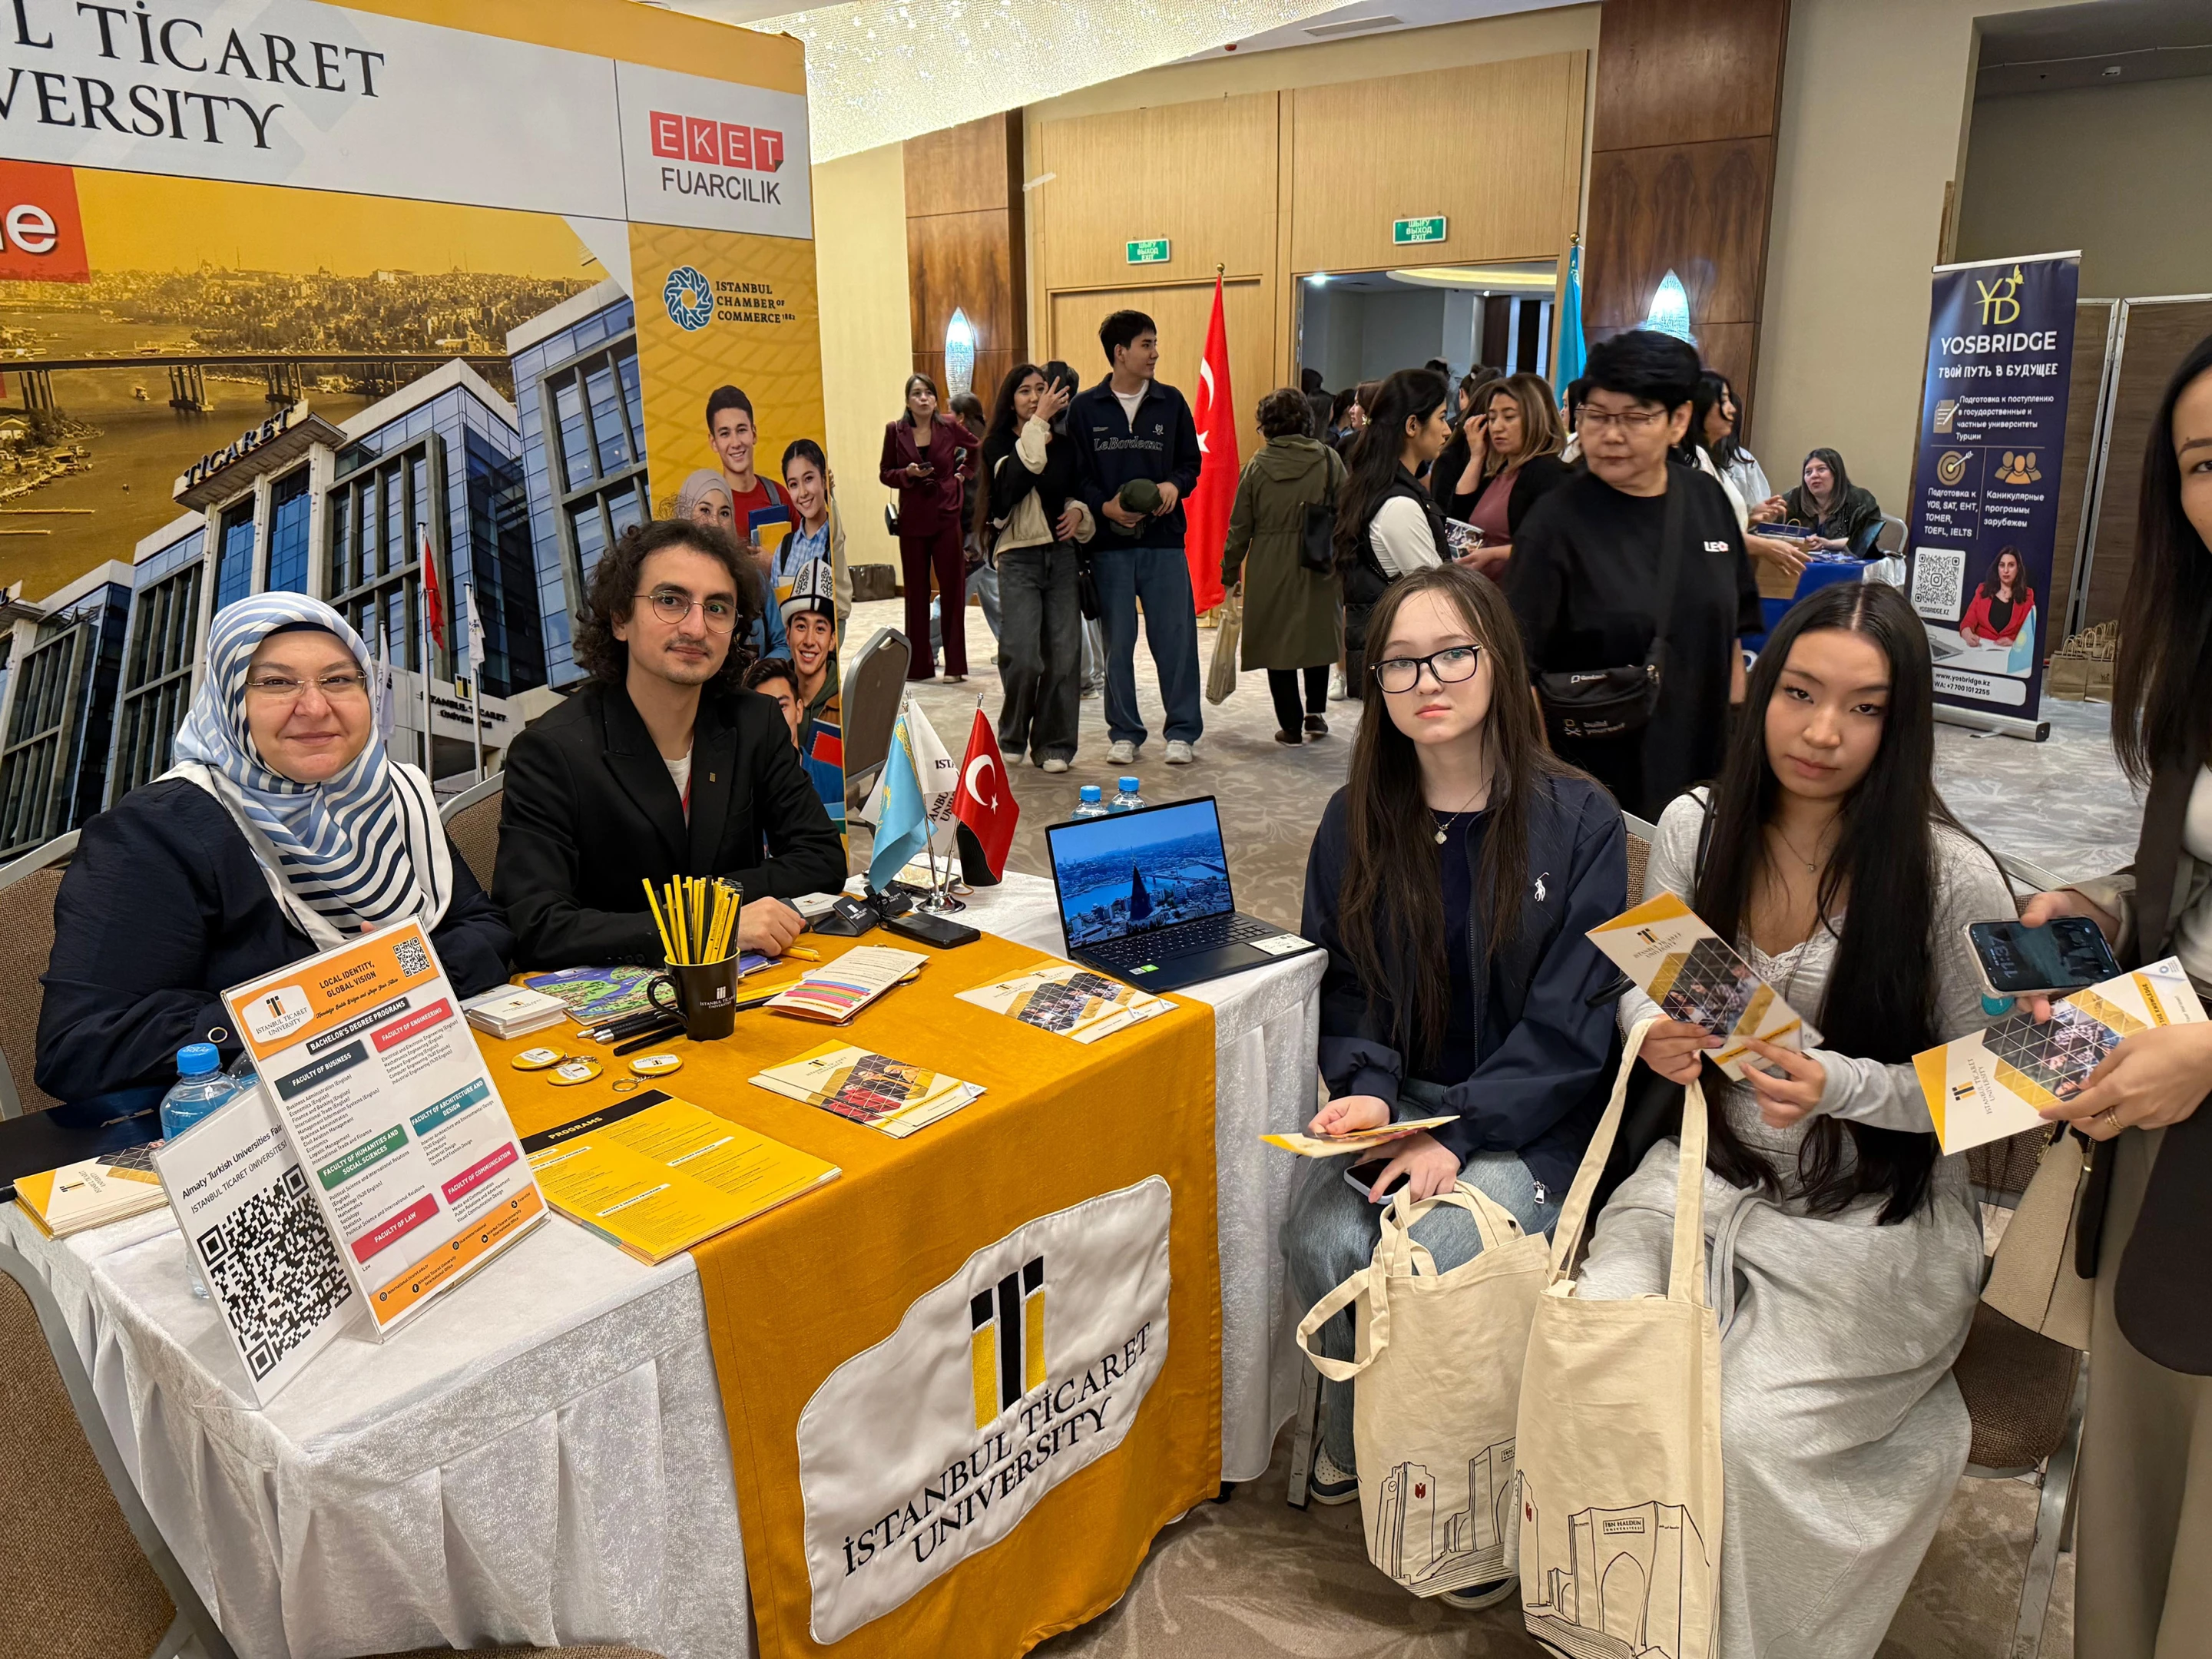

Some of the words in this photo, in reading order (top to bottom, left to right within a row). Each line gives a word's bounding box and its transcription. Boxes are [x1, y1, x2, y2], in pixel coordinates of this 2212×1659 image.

[78, 0, 385, 98] TİCARET
[659, 118, 778, 166] EKET
[661, 167, 782, 205] FUARCILIK
[0, 204, 56, 253] e
[1406, 226, 1432, 234] ВЫХОД
[715, 280, 773, 294] ISTANBUL
[716, 296, 775, 309] CHAMBER
[717, 310, 781, 323] COMMERCE
[1940, 331, 2057, 355] YOSBRIDGE
[1939, 365, 1962, 378] ТВОЙ
[1964, 365, 1992, 378] ПУТЬ
[1995, 365, 2003, 377] В
[2006, 363, 2058, 378] БУДУЩЕЕ
[1959, 396, 2000, 406] Подготовка
[2008, 395, 2054, 404] поступлению
[1963, 408, 2026, 417] государственные
[1955, 432, 1982, 441] Турции
[1957, 420, 1986, 429] частные
[1988, 420, 2038, 429] университеты
[1928, 488, 1969, 498] Подготовка
[1987, 490, 2045, 502] Каникулярные
[1926, 513, 1952, 524] TOMER,
[1927, 501, 1941, 511] YOS,
[1943, 502, 1958, 512] SAT,
[1985, 505, 2030, 514] программы
[1924, 526, 1949, 537] TOEFL,
[1951, 528, 1972, 537] IELTS
[1936, 673, 1990, 686] www.yosbridge.kz
[319, 975, 342, 988] LOCAL
[342, 961, 374, 979] IDENTITY,
[326, 982, 354, 997] GLOBAL
[353, 971, 376, 985] VISION
[268, 1017, 300, 1035] UNIVERSITY
[310, 1027, 349, 1050] BACHELOR'S
[349, 1015, 373, 1031] DEGREE
[373, 1000, 405, 1019] PROGRAMS
[382, 1026, 402, 1041] FACULTY
[410, 1007, 442, 1026] ENGINEERING
[292, 1069, 316, 1086] FACULTY
[324, 1052, 351, 1069] BUSINESS
[286, 1099, 305, 1111] Business
[306, 1084, 334, 1101] Administration
[411, 1109, 432, 1124] FACULTY
[439, 1085, 473, 1108] ARCHITECTURE
[473, 1080, 483, 1089] AND
[442, 1102, 460, 1116] DESIGN
[289, 1103, 311, 1117] Economics
[291, 1112, 308, 1123] Finance
[316, 1099, 333, 1110] Banking
[294, 1112, 321, 1128] International
[297, 1118, 323, 1134] Management
[323, 1106, 346, 1121] Information
[346, 1098, 363, 1108] Systems
[300, 1128, 320, 1141] Business
[320, 1113, 348, 1130] Administration
[303, 1138, 313, 1147] Civil
[313, 1131, 329, 1141] Aviation
[329, 1117, 353, 1132] Management
[548, 1117, 603, 1140] PROGRAMS
[306, 1139, 328, 1153] Economics
[308, 1148, 325, 1159] Logistic
[324, 1134, 349, 1150] Management
[311, 1147, 337, 1165] International
[337, 1141, 349, 1150] Trade
[356, 1128, 372, 1139] Finance
[323, 1158, 346, 1176] FACULTY
[347, 1154, 354, 1162] OF
[355, 1135, 386, 1157] HUMANITIES
[387, 1129, 398, 1139] AND
[183, 1177, 207, 1199] Almaty
[207, 1160, 232, 1180] Turkish
[233, 1133, 270, 1162] Universities
[270, 1124, 282, 1136] Fair
[342, 1160, 362, 1174] SOCIAL
[362, 1144, 387, 1163] SCIENCES
[190, 1188, 222, 1214] İSTANBUL
[222, 1167, 247, 1190] TİCARET
[248, 1139, 286, 1171] ÜNİVERSİTESİ
[329, 1188, 346, 1200] Political
[345, 1180, 360, 1191] Science
[368, 1161, 392, 1177] International
[392, 1151, 409, 1163] Relations
[448, 1177, 468, 1194] FACULTY
[475, 1150, 511, 1176] COMMUNICATION
[334, 1197, 356, 1213] Psychology
[337, 1201, 363, 1218] Mathematics
[339, 1211, 359, 1224] Sociology
[343, 1217, 361, 1230] Statistics
[374, 1224, 396, 1242] FACULTY
[397, 1219, 404, 1227] OF
[404, 1211, 416, 1223] LAW
[842, 1434, 1012, 1578] İSTANBUL
[1019, 1322, 1152, 1436] TİCARET
[911, 1396, 1114, 1565] UNIVERSITY
